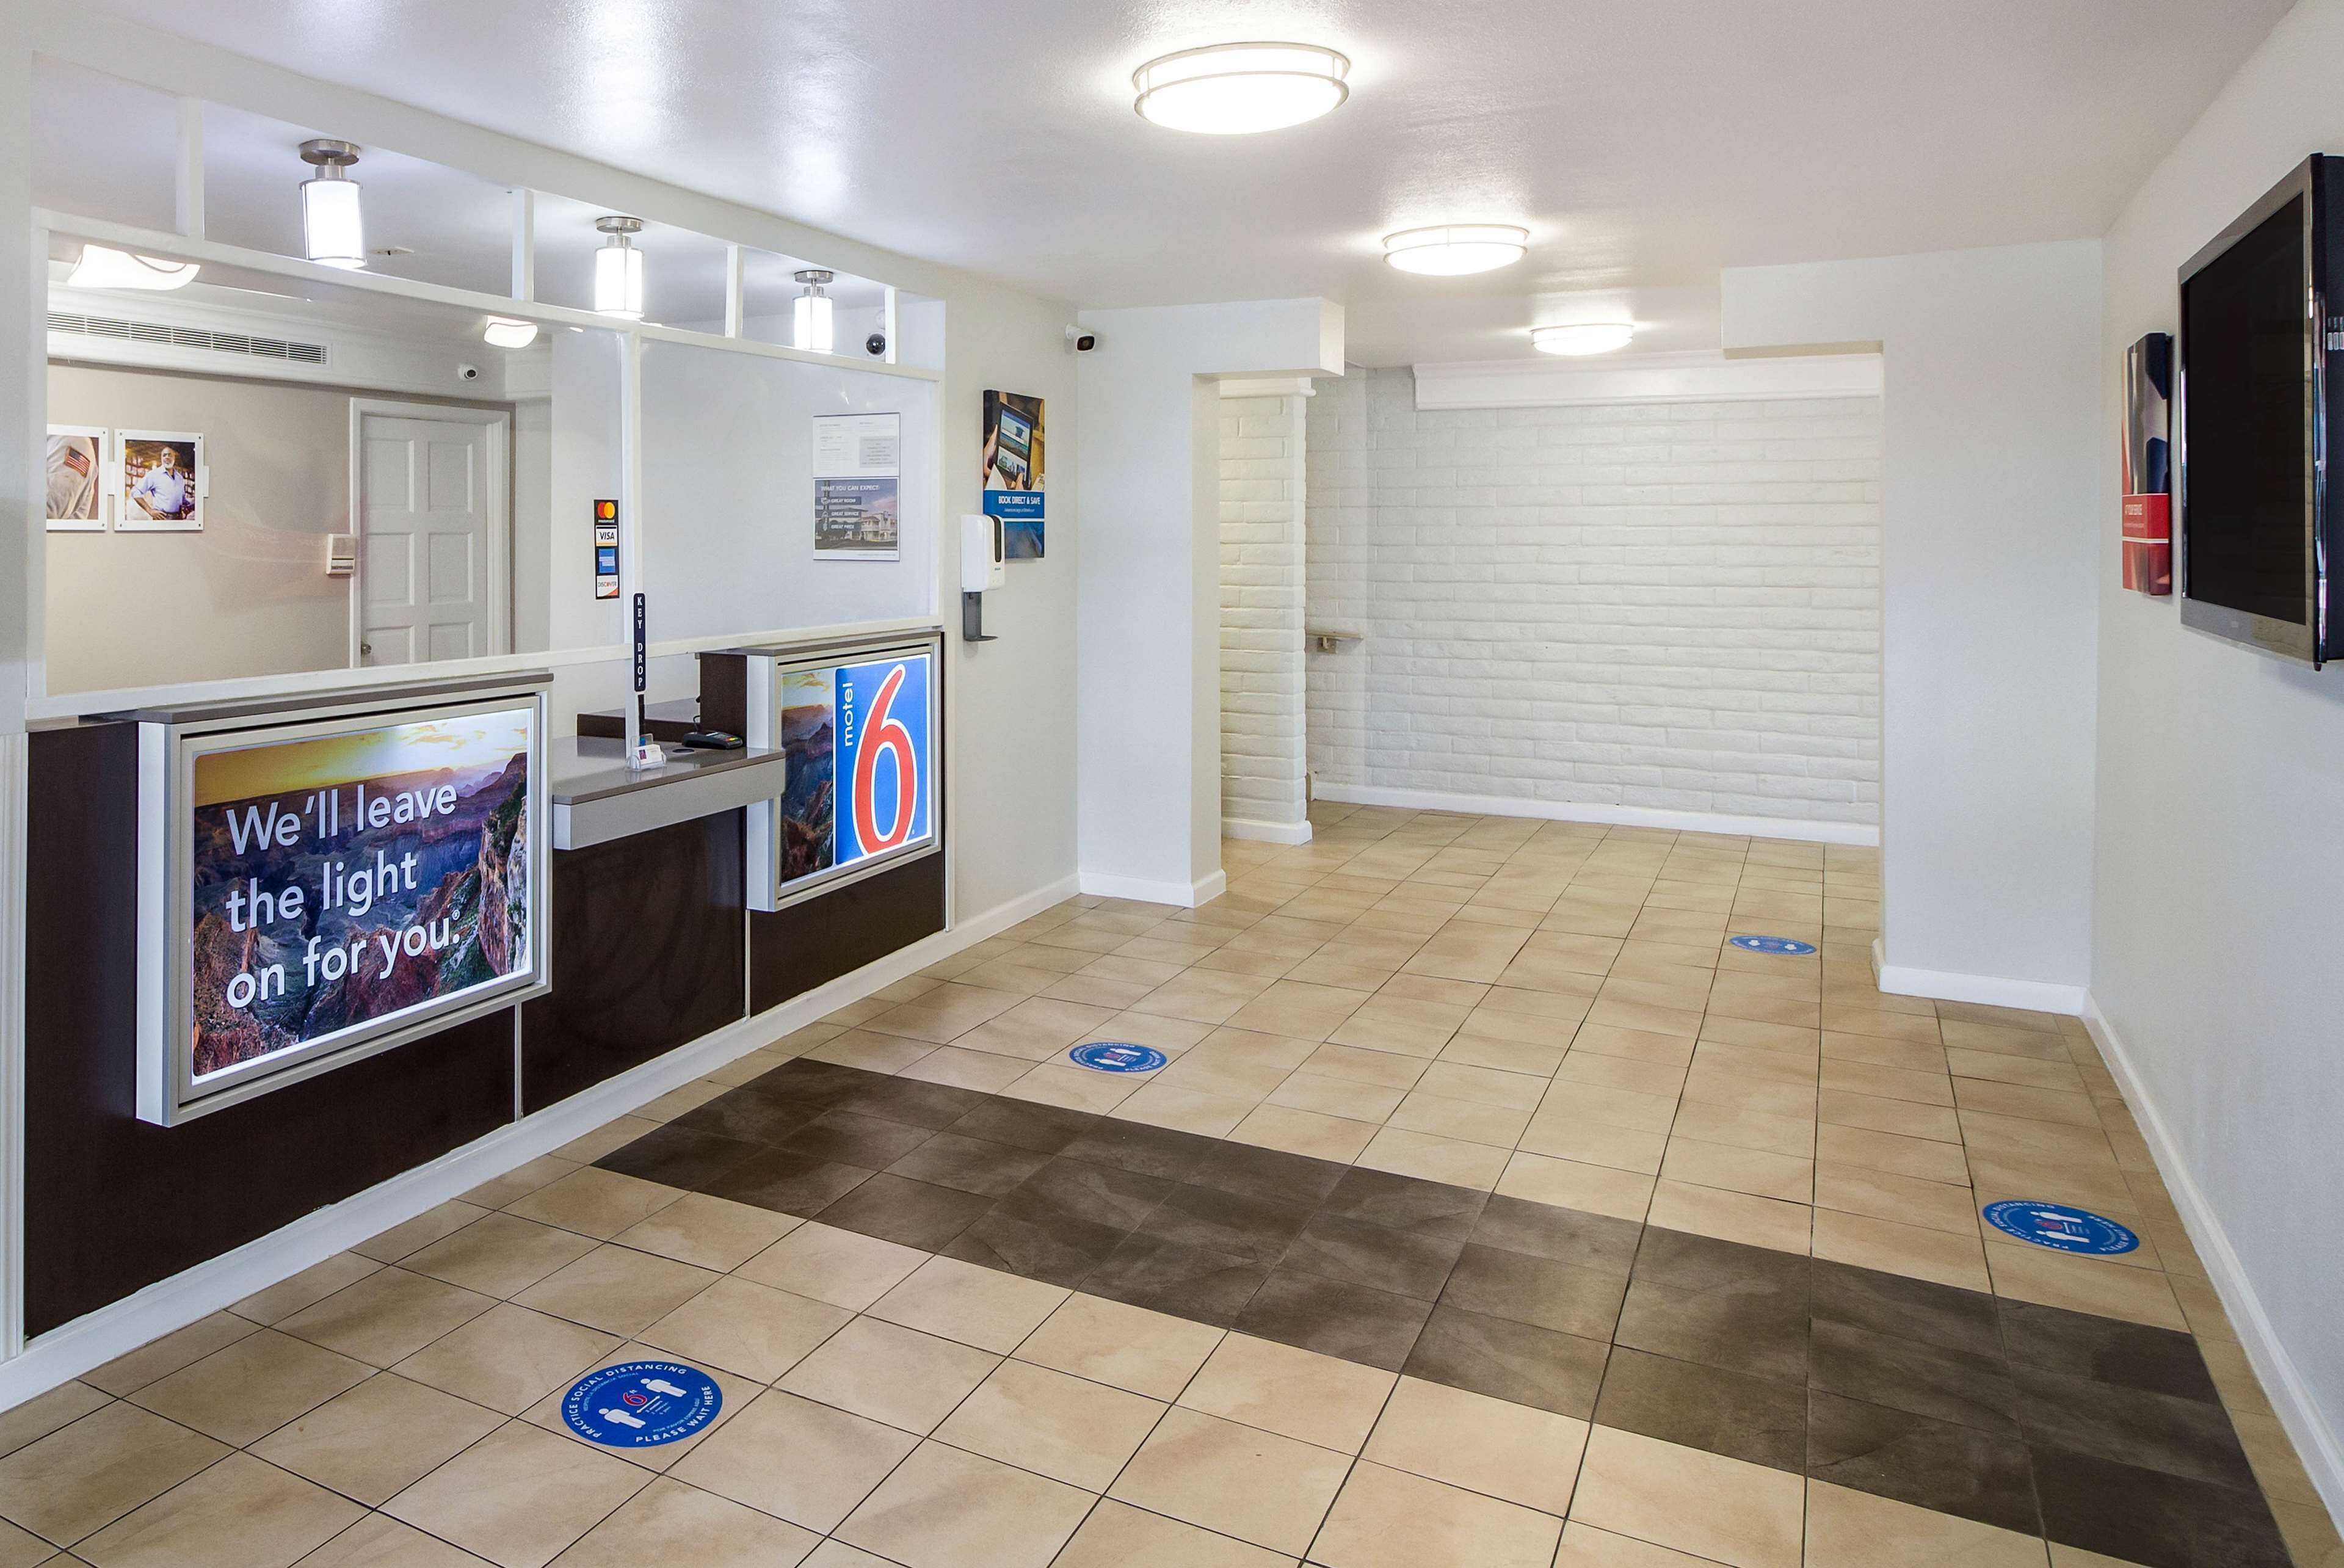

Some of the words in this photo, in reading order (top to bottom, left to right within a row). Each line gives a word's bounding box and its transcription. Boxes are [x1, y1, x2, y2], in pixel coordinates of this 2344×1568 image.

[842, 681, 854, 747] motel
[852, 664, 918, 856] 6
[357, 785, 458, 832] leave
[225, 877, 305, 933] the
[322, 851, 418, 917] light
[227, 964, 285, 1009] on
[303, 936, 368, 988] for
[571, 1376, 603, 1401] SOCIAL
[606, 1364, 688, 1375] DISTANCING
[568, 1404, 603, 1438] PRACTICE
[636, 1426, 687, 1443] PLEASE
[686, 1407, 711, 1427] WAIT
[702, 1385, 713, 1406] HERE
